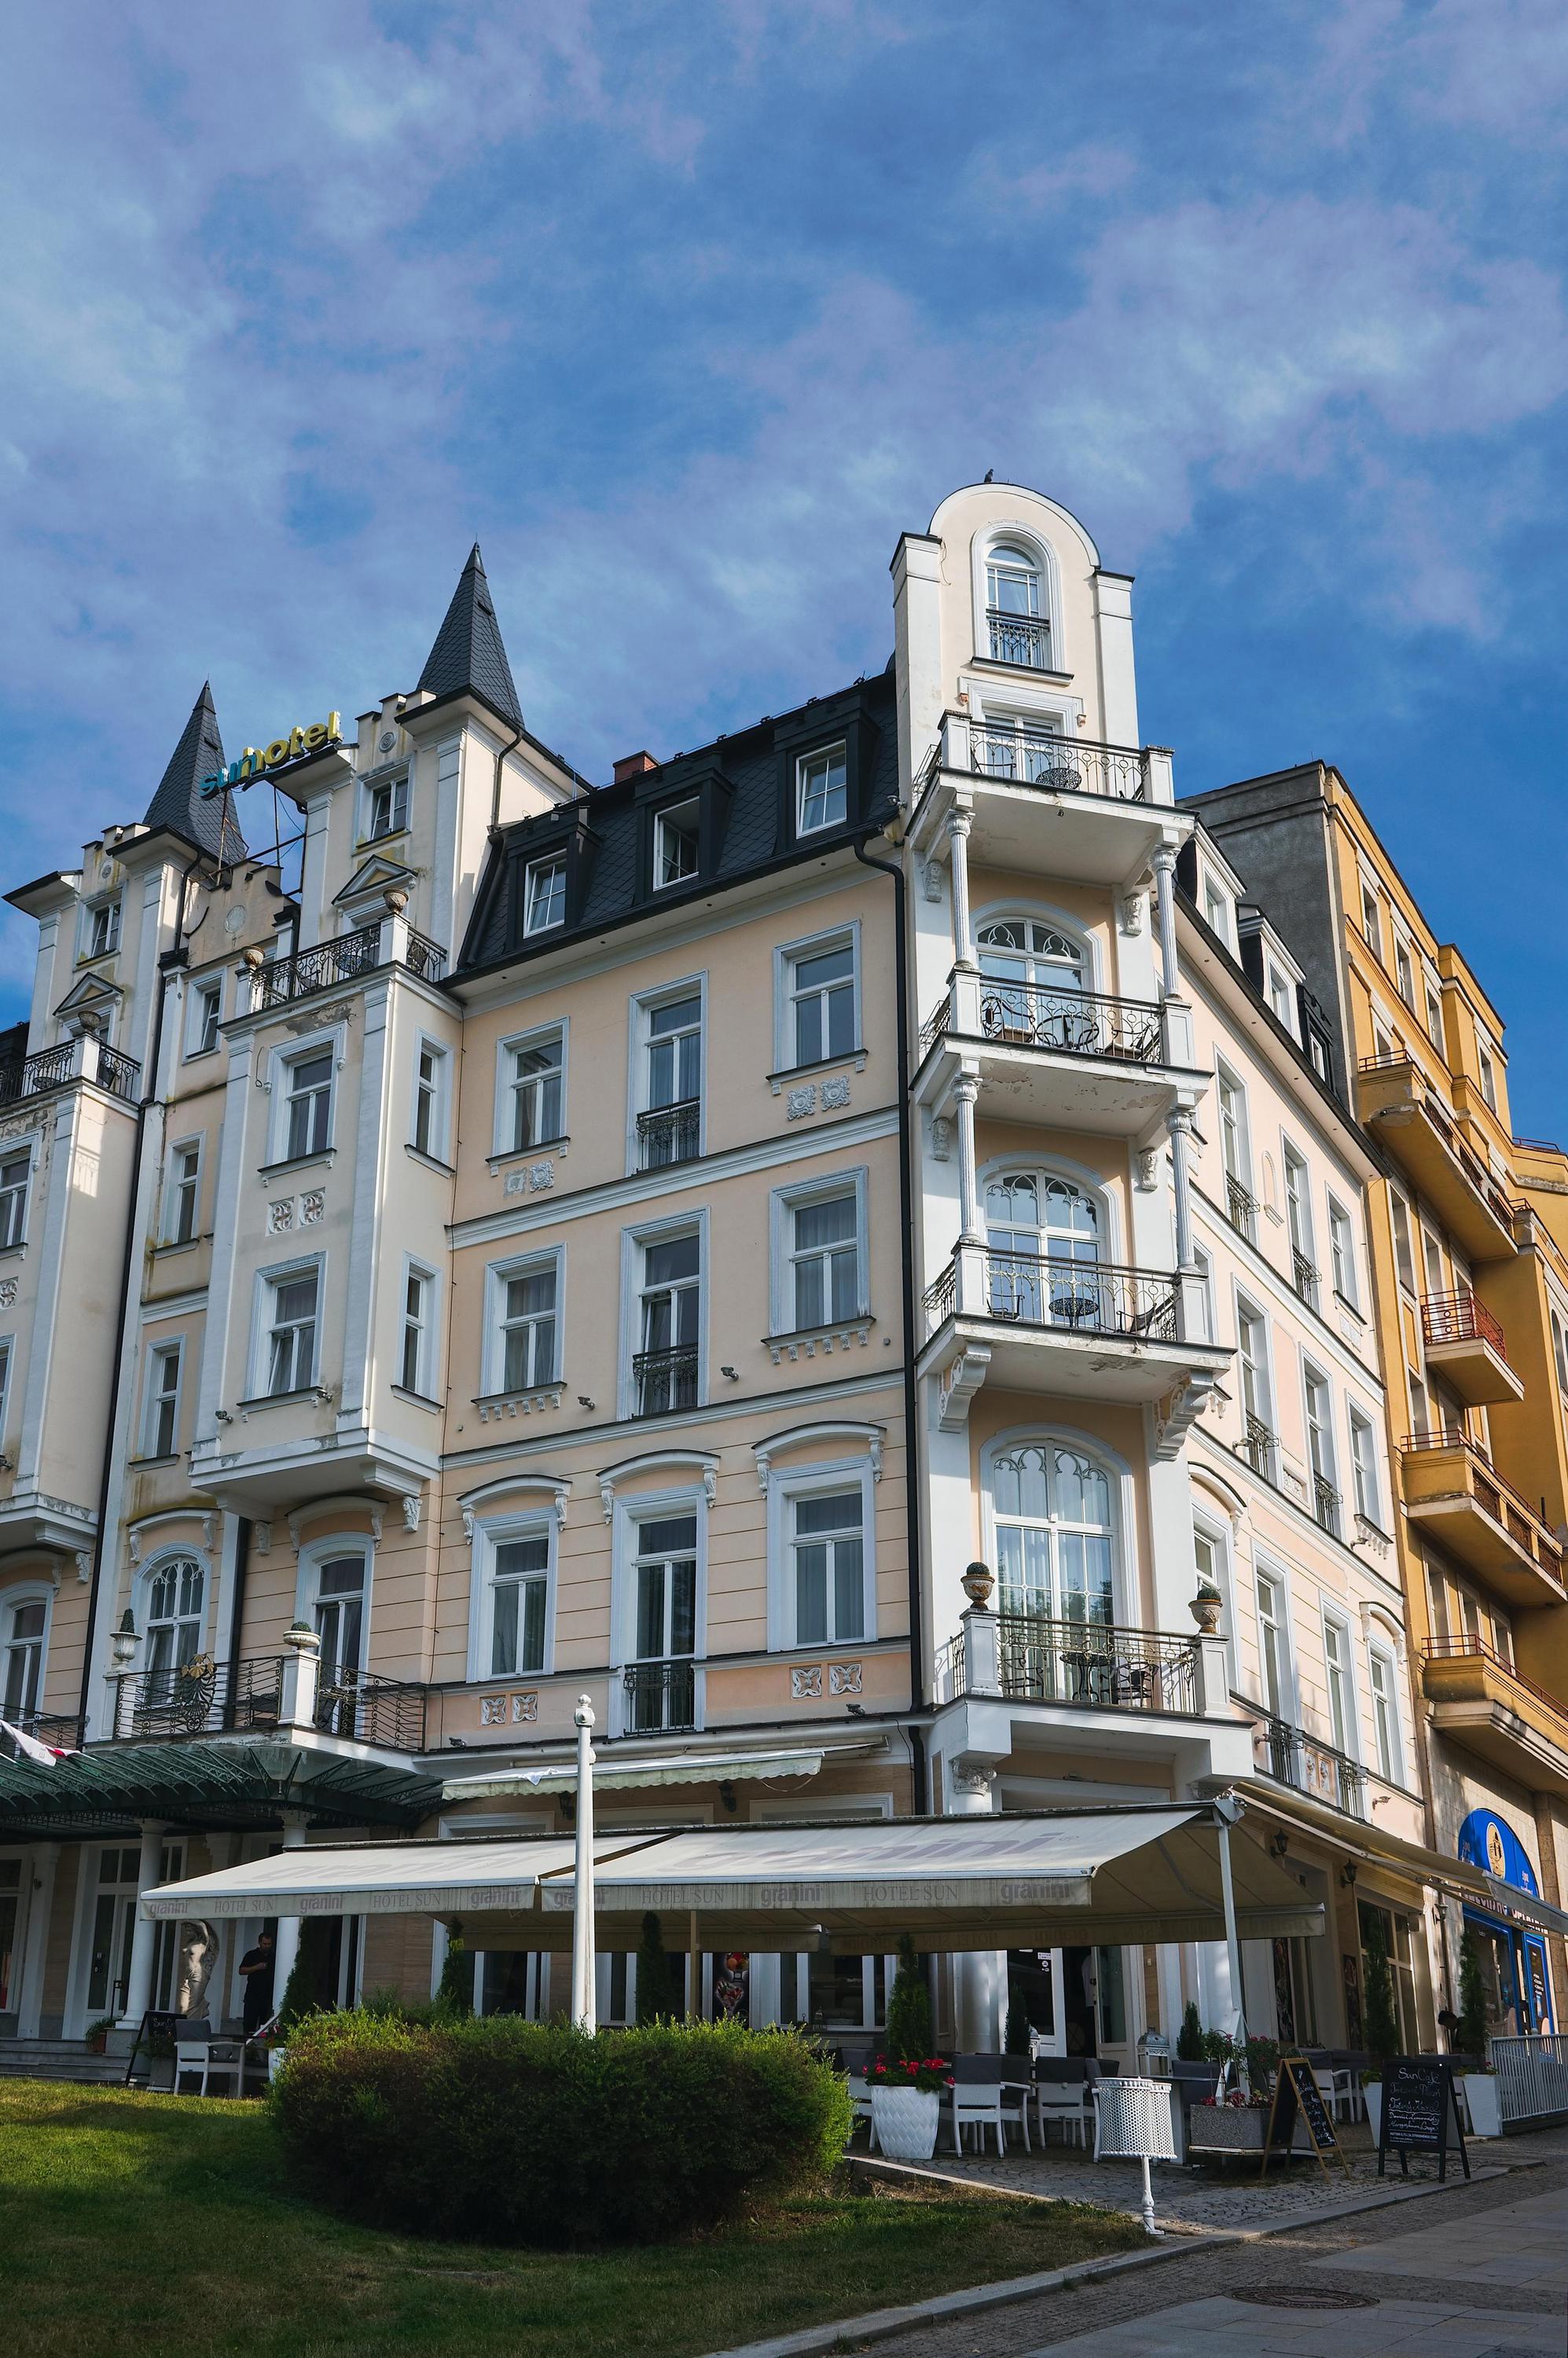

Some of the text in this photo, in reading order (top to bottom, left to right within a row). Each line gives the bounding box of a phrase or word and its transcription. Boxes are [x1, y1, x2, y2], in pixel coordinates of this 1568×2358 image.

[198, 711, 343, 800] sun hotel
[657, 1831, 1067, 1872] granini
[149, 1886, 522, 1919] granini HOTEL SUN granini HOTEL SUN granini
[641, 1889, 690, 1904] HOTEL
[692, 1887, 725, 1904] SUN
[761, 1886, 821, 1907] granini
[863, 1886, 921, 1901] HOTEL
[923, 1885, 959, 1901] SUN
[1000, 1880, 1071, 1903] granini
[1398, 2067, 1418, 2080] Sun
